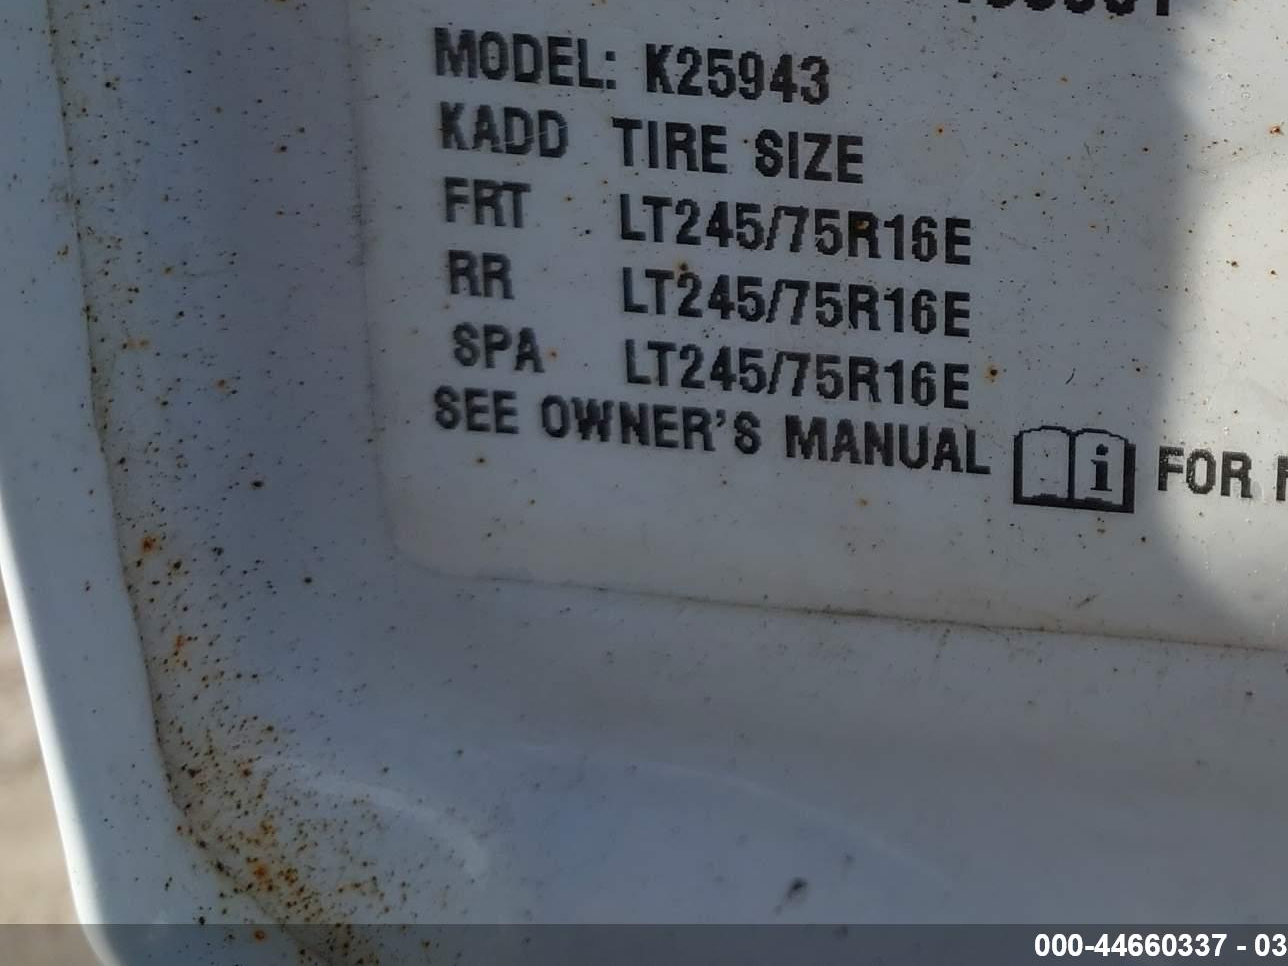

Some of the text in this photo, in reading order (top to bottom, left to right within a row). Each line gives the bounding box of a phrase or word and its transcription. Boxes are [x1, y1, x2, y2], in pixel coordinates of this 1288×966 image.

[433, 27, 831, 105] MODEL: K25943
[439, 102, 569, 158] KADD
[612, 116, 865, 184] TIRE SIZE
[444, 179, 531, 229] FRT
[620, 193, 973, 267] LT245/75R16E
[448, 252, 513, 300] RR
[621, 268, 972, 338] LT245/75R16E
[451, 326, 545, 375] SPA
[624, 340, 970, 410] LT245/75R16E
[433, 386, 991, 476] SEE OWNER'S MANUAL
[1157, 446, 1253, 499] FOR
